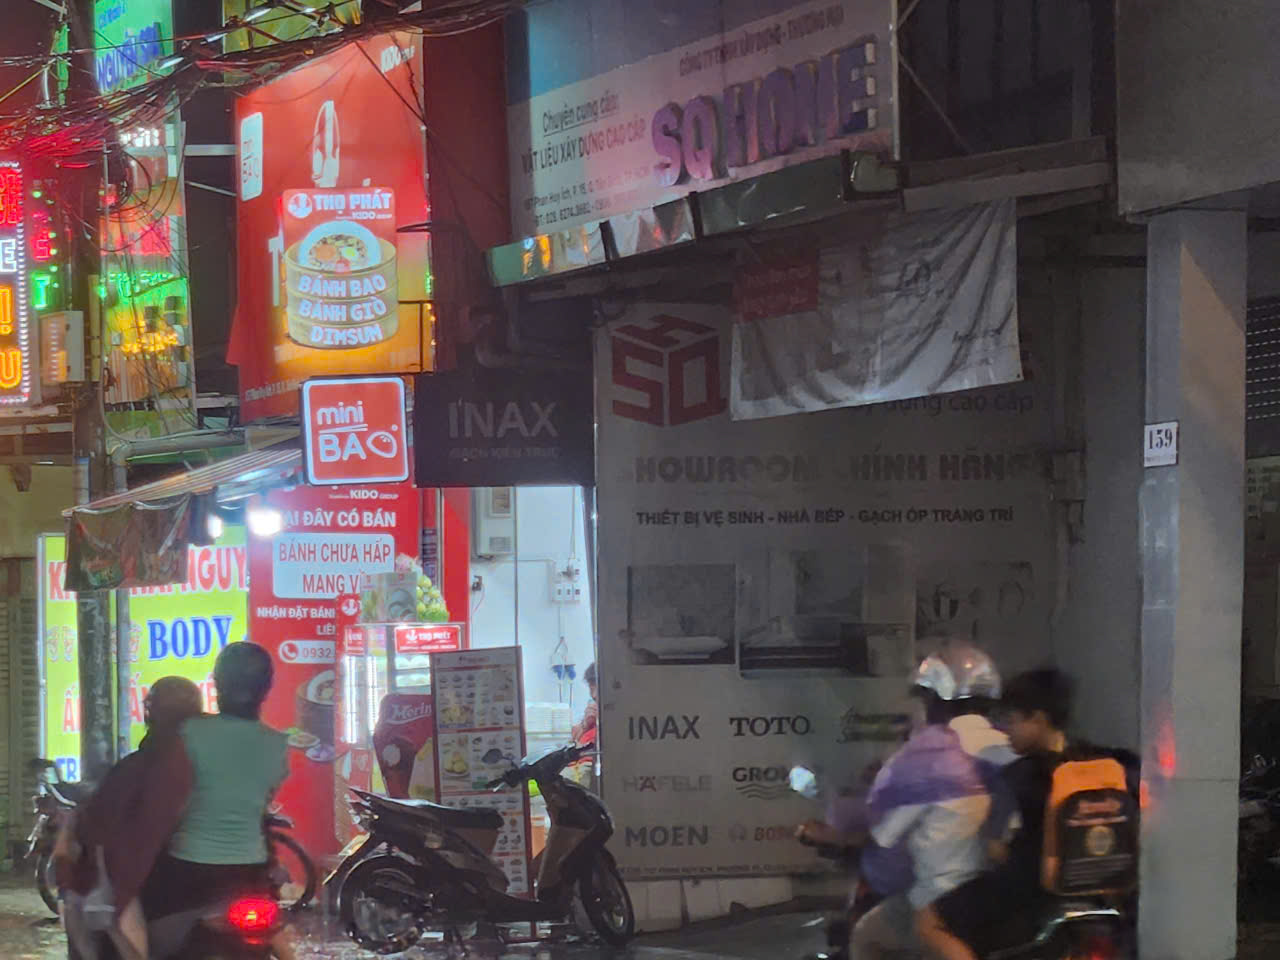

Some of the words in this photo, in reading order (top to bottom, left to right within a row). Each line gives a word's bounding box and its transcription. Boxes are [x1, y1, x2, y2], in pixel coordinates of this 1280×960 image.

[651, 93, 719, 187] SQ
[723, 35, 878, 178] HOME
[313, 194, 345, 214] THỌ
[349, 189, 393, 210] PHÁT
[298, 274, 346, 297] BÁNH
[349, 274, 386, 296] BAO
[298, 297, 347, 321] BÁNH
[350, 296, 387, 321] GIÒ
[310, 323, 384, 345] DIMSUM
[317, 400, 365, 426] mini
[448, 401, 559, 439] INAX
[1149, 428, 1173, 450] 159
[349, 489, 379, 499] KIDO
[281, 510, 300, 529] ẠI
[303, 508, 334, 527] ĐÂY
[337, 507, 360, 527] CÓ
[362, 507, 397, 528] BÁN
[636, 507, 680, 525] THIẾT
[683, 510, 700, 529] BỊ
[702, 508, 724, 529] VỆ
[727, 511, 765, 525] SINH
[777, 506, 811, 525] NHÀ
[858, 508, 902, 527] GẠCH
[932, 508, 984, 523] TRANG
[989, 505, 1015, 522] TRÍ
[279, 540, 317, 562] BÁNH
[320, 541, 360, 563] CHƯA
[362, 537, 392, 564] HẤP
[303, 574, 345, 595] MANG
[256, 605, 286, 621] NHẬN
[288, 606, 309, 621] ĐẶT
[147, 615, 233, 661] BODY
[390, 702, 433, 721] Merin
[627, 714, 701, 741] INAX
[728, 715, 812, 738] TOTO
[623, 774, 713, 793] HÄFELE
[732, 766, 791, 784] GROH
[624, 823, 709, 848] MOEN
